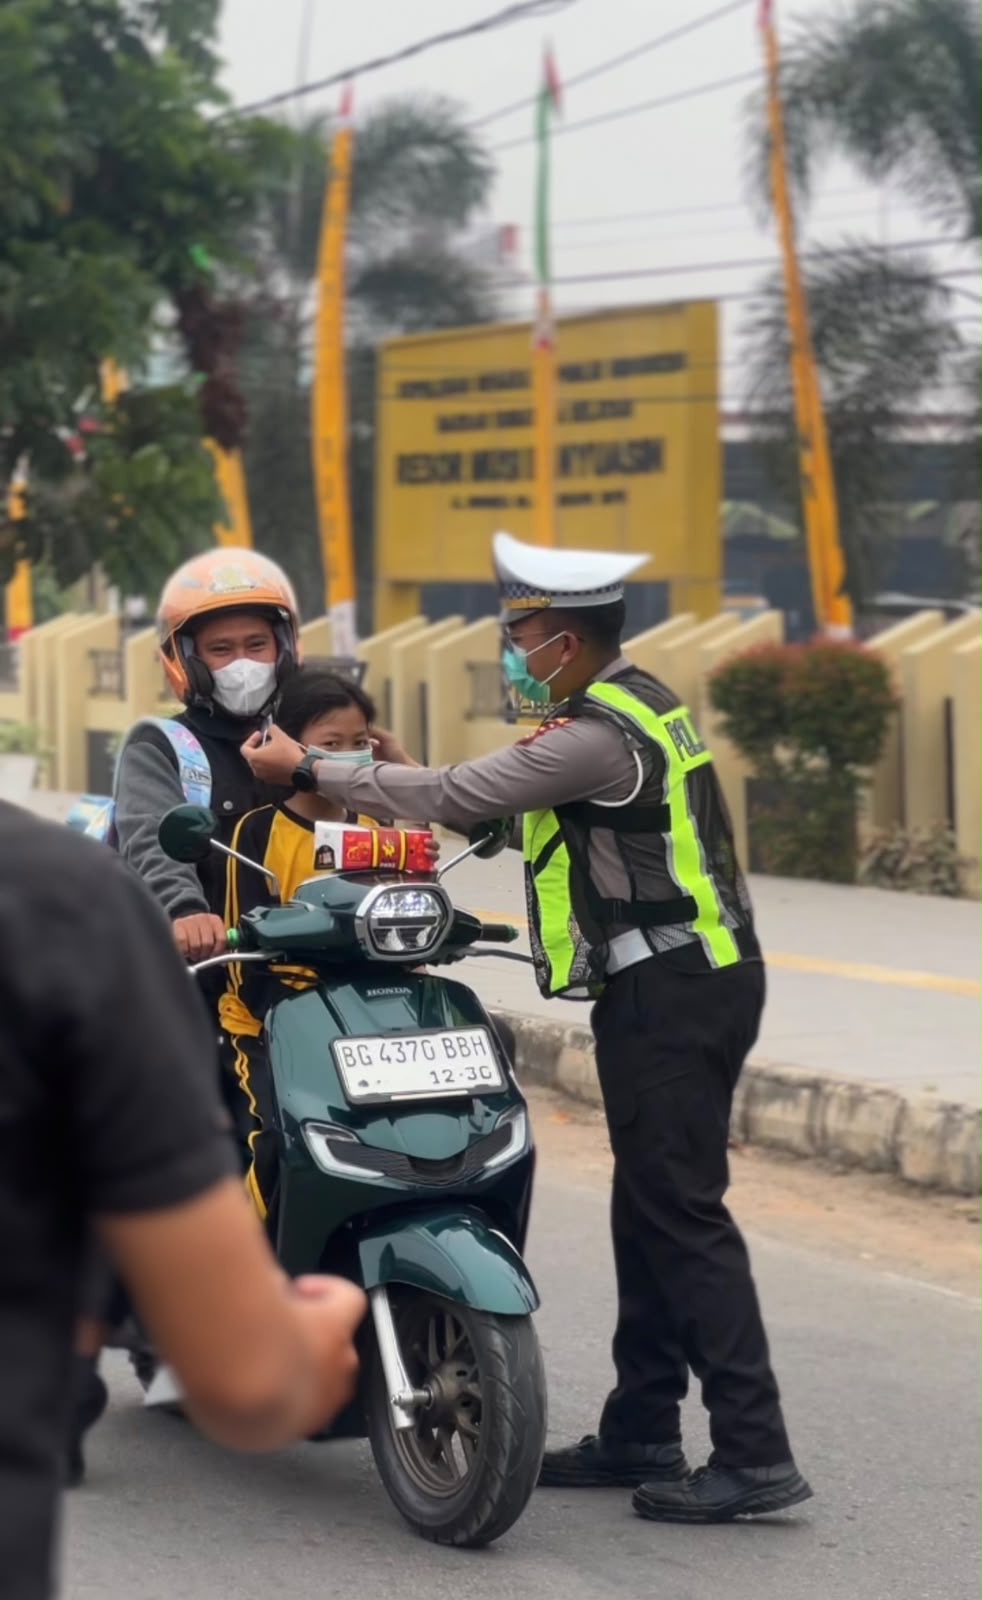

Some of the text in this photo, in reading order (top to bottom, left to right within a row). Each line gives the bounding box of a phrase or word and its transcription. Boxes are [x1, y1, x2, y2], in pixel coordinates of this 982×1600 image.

[664, 717, 706, 762] POL
[366, 986, 413, 997] HONDA
[342, 1035, 487, 1068] BG 4370 BBH
